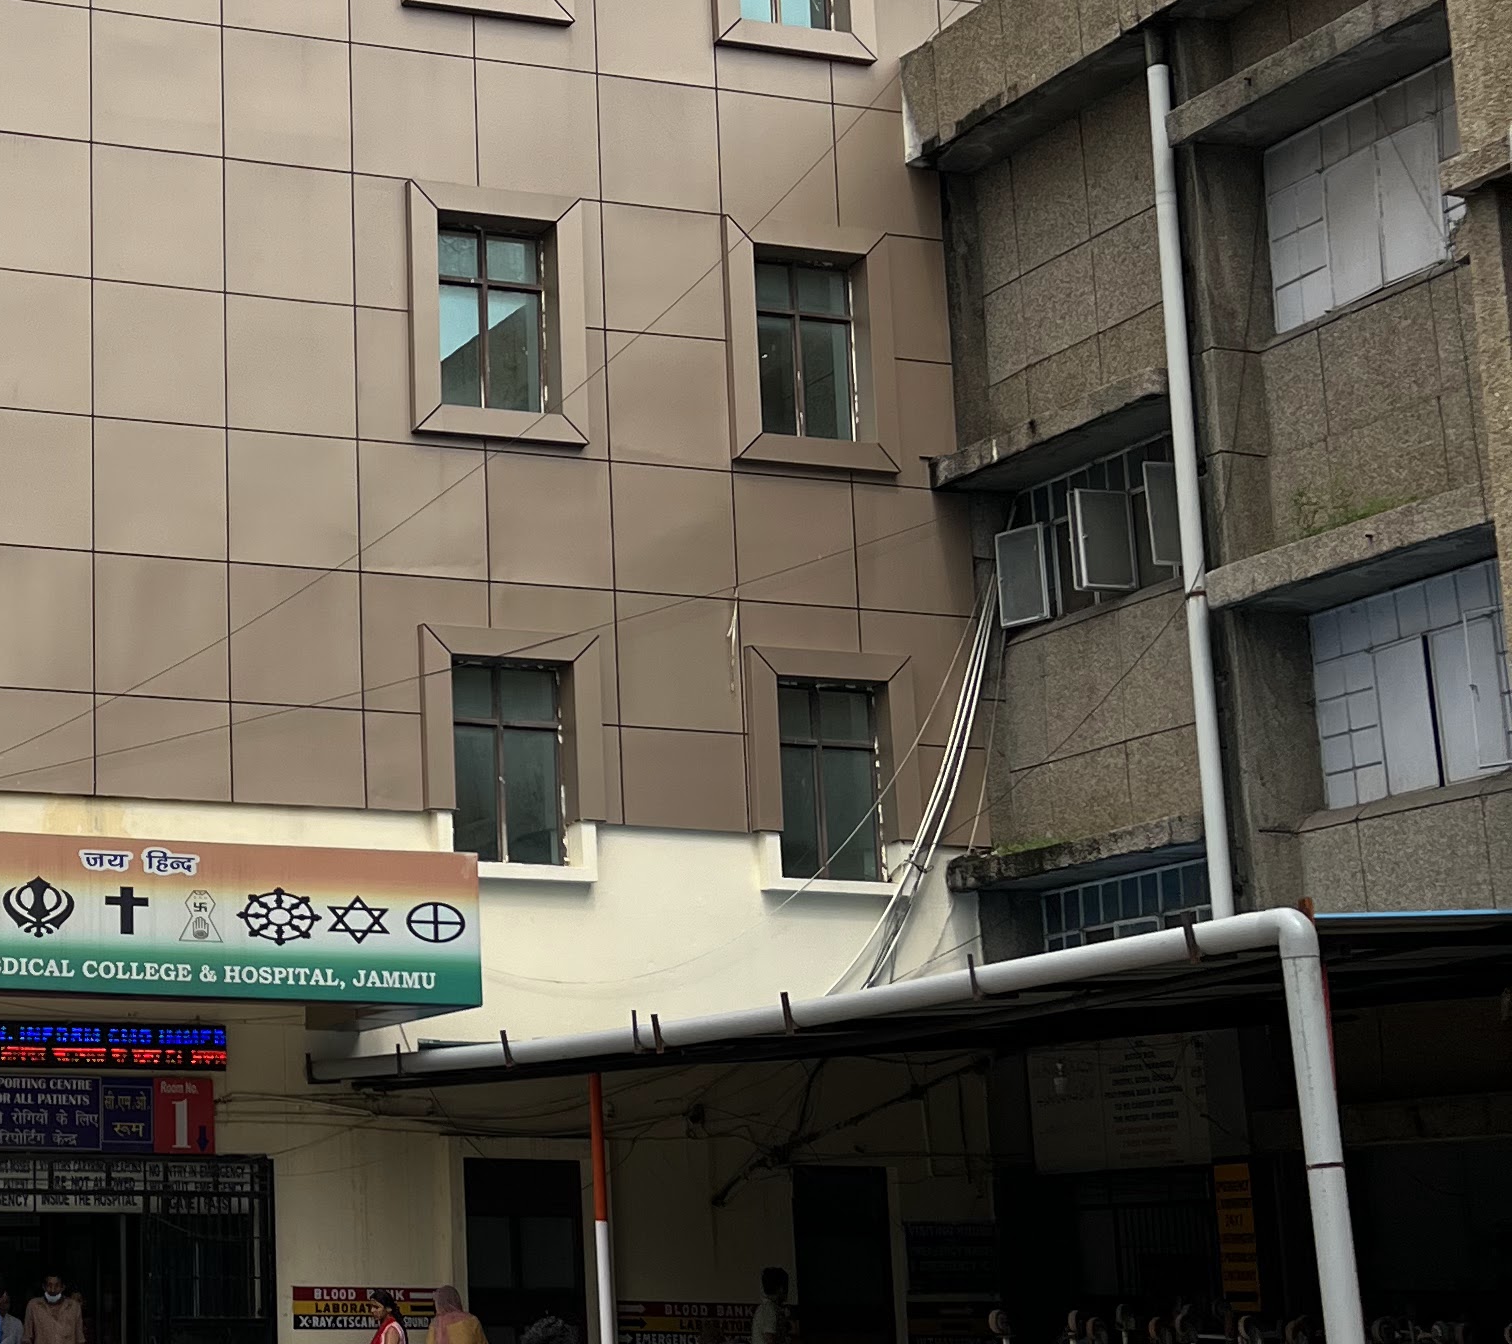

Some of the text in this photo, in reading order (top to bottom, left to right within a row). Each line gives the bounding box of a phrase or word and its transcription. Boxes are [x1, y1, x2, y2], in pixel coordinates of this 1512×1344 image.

[83, 850, 196, 873] जय हिन्द
[82, 959, 192, 982] COLLEGE
[199, 964, 217, 983] &
[223, 965, 346, 989] HOSPITAL,
[352, 970, 437, 989] JAMMU
[50, 1078, 93, 1091] CENTRE
[160, 1080, 199, 1095] Room No.
[13, 1092, 34, 1104] ALL
[38, 1093, 90, 1106] PATIENTS
[56, 1109, 68, 1126] के
[75, 1110, 99, 1128] लिए
[172, 1098, 191, 1148] 1
[112, 1122, 145, 1138] रूम
[41, 1194, 138, 1206] INSIDE THE HOSPITAL
[313, 1288, 357, 1300] BLOOD
[663, 1304, 753, 1317] BLOOD BANK
